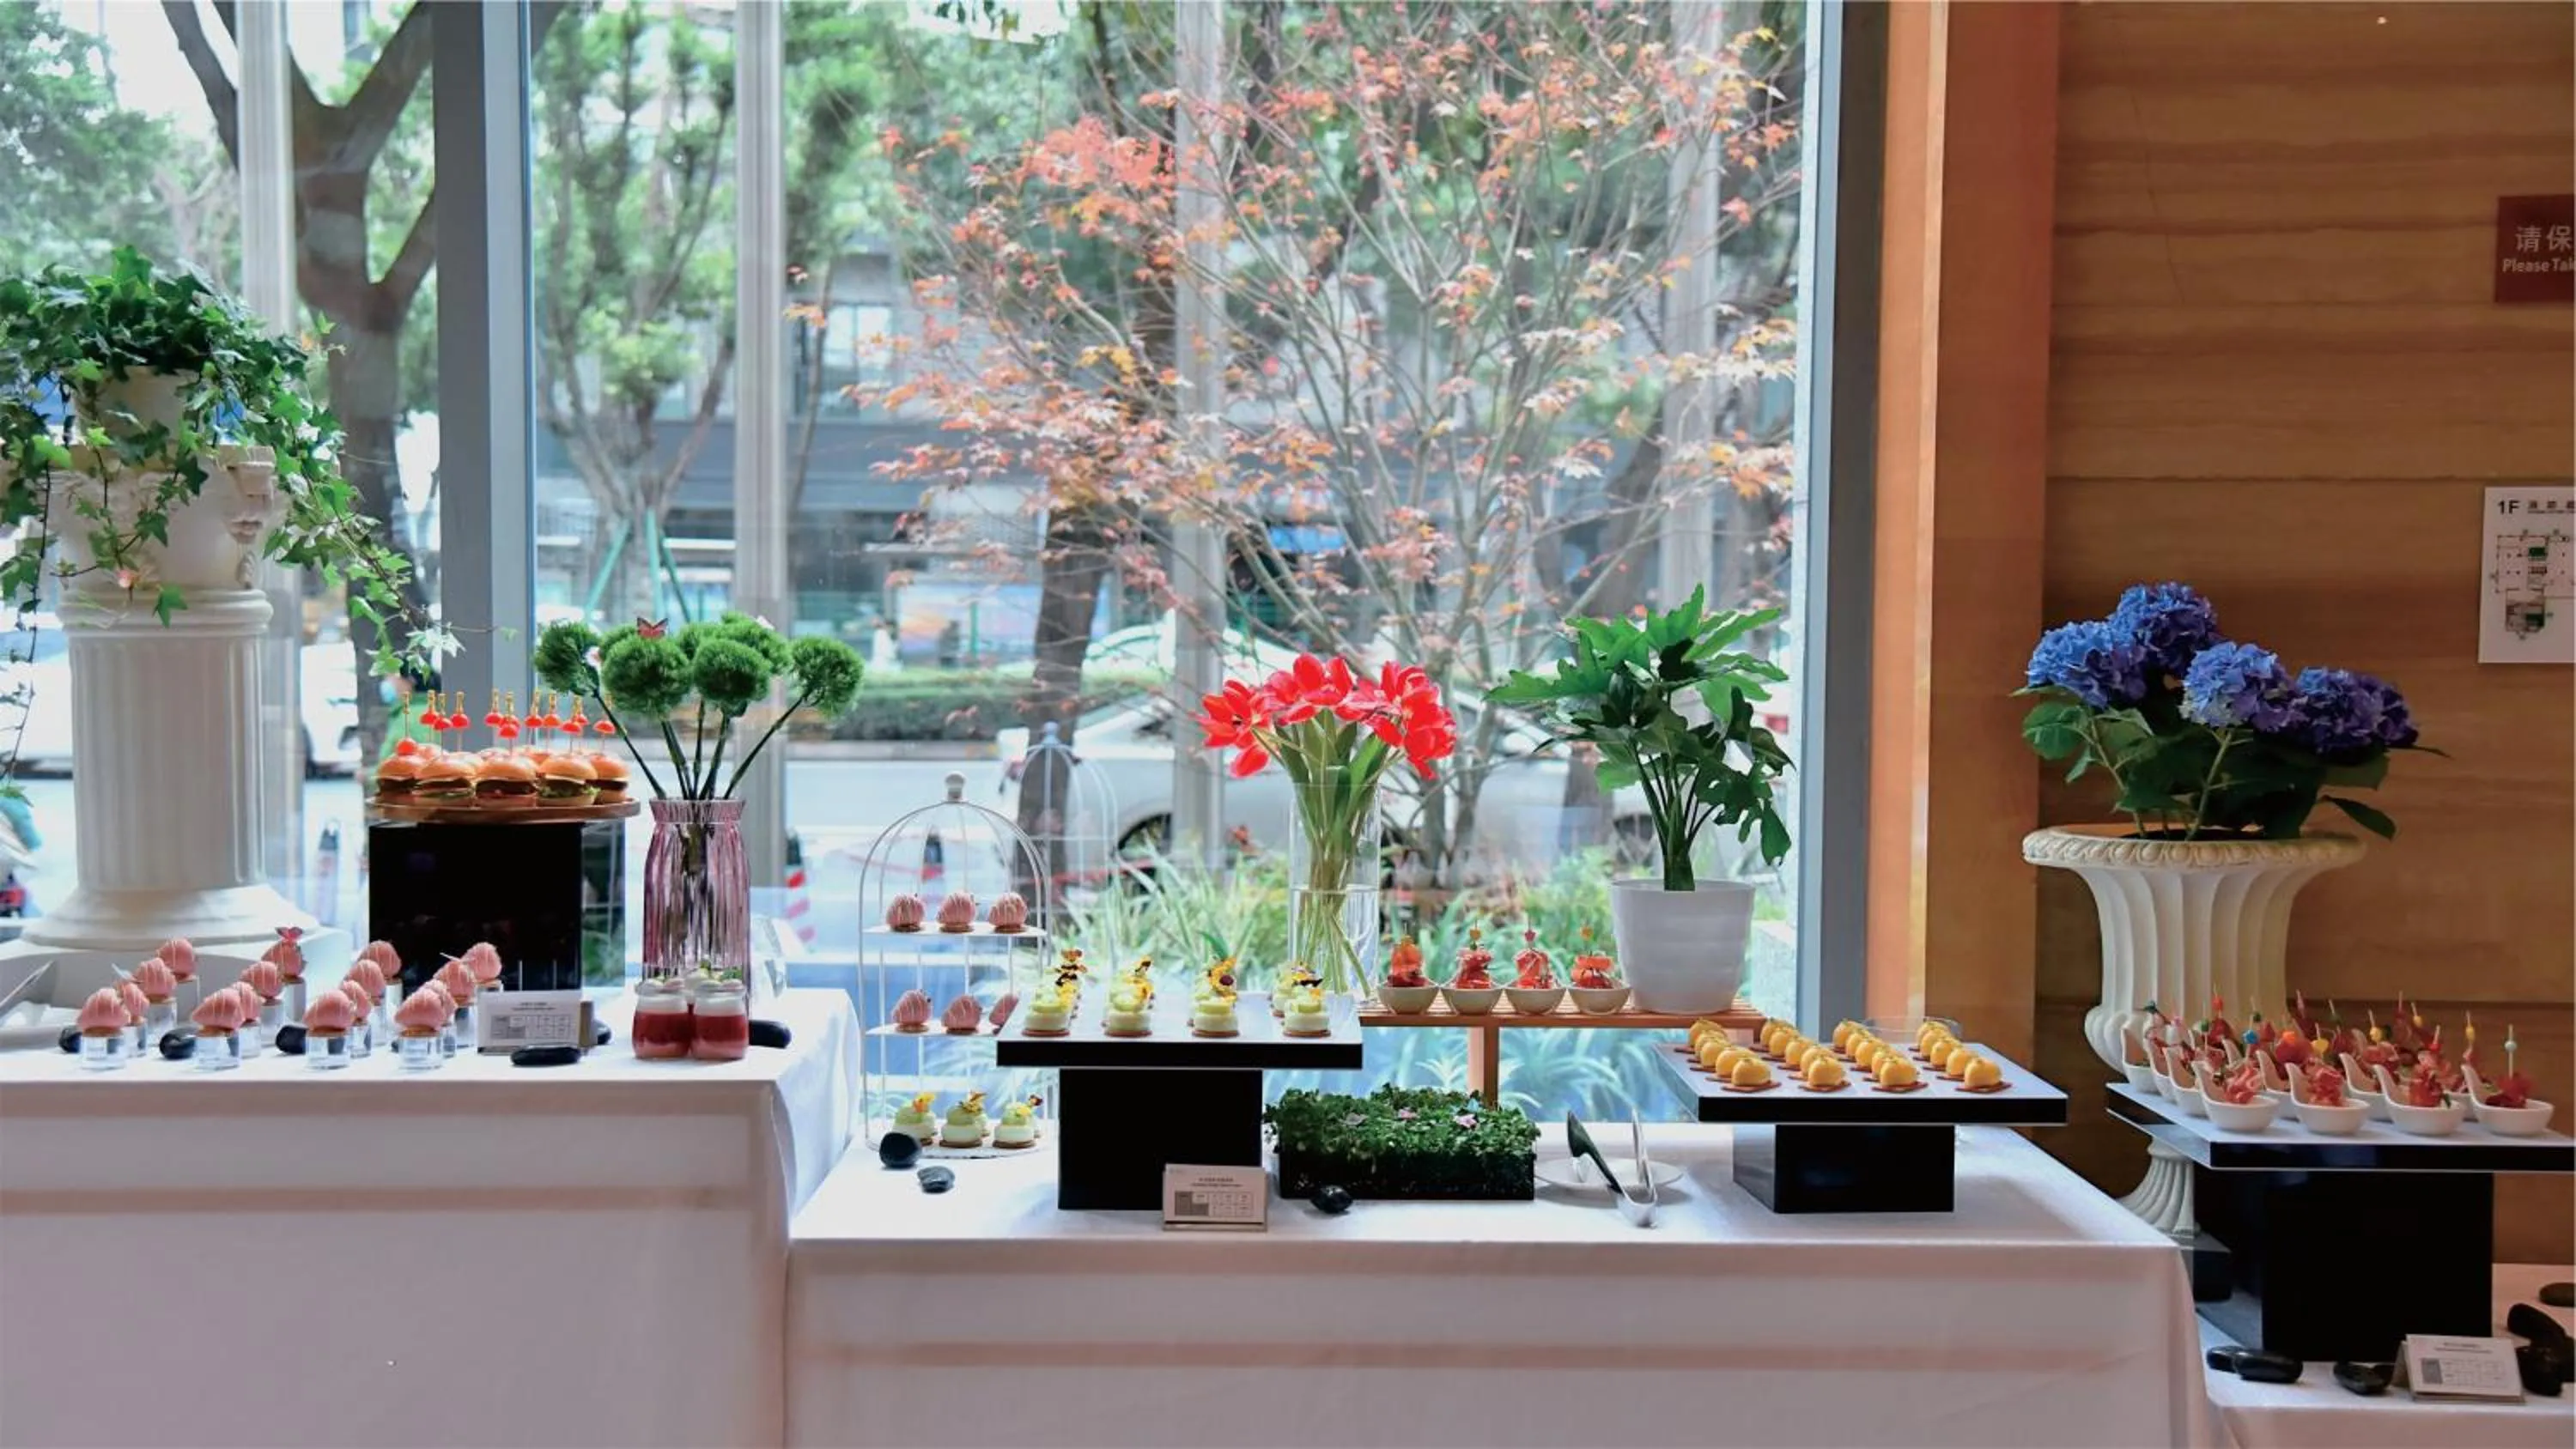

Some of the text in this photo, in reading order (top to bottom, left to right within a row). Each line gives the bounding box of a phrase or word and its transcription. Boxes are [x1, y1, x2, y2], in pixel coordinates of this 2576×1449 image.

[2515, 225, 2573, 252] 请保
[2502, 258, 2549, 272] Please
[2498, 500, 2520, 514] 1F
